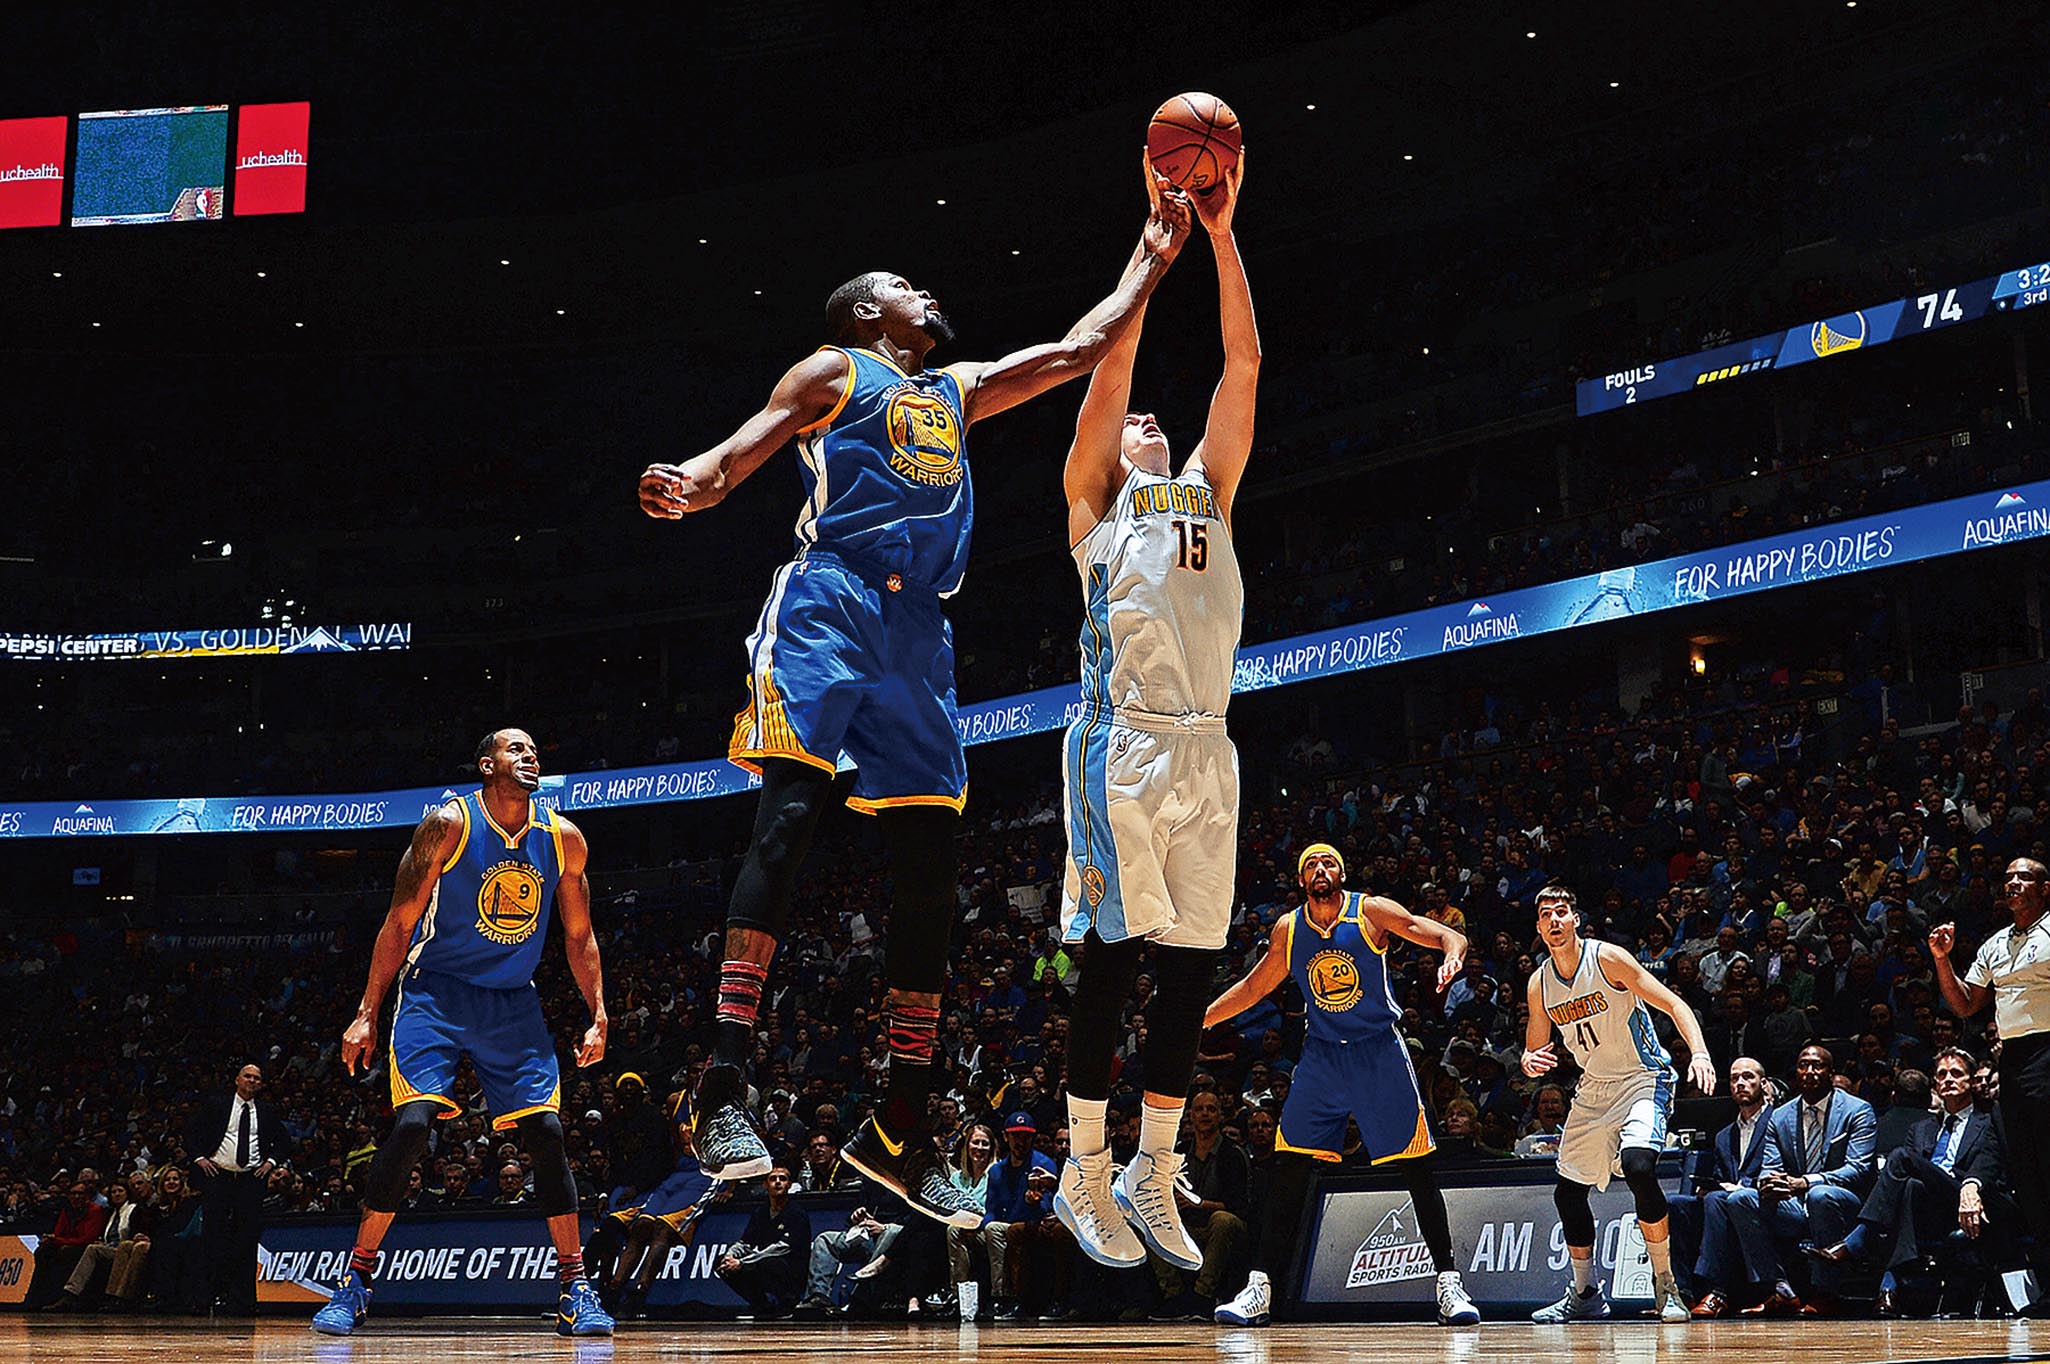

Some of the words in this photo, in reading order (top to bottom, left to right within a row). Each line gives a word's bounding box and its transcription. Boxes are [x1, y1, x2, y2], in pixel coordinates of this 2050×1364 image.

[242, 149, 302, 167] uchealth
[0, 163, 59, 180] uchealth
[1917, 288, 1963, 329] 74
[2024, 288, 2047, 305] 3rd
[1605, 364, 1655, 390] FOULS
[1625, 387, 1637, 404] 2
[920, 410, 947, 430] 35
[1171, 520, 1209, 573] 15
[1674, 564, 1720, 599] FOR
[1727, 547, 1796, 587] HAPPY
[1801, 527, 1895, 572] BODIES
[1442, 613, 1520, 651] AQUAFINA
[0, 638, 55, 654] PEPSI
[61, 638, 137, 654] CENTER
[1273, 643, 1327, 677] HAPPY
[1330, 628, 1403, 668] BODIES
[972, 704, 1031, 738] BODIES
[571, 781, 602, 805] FOR
[607, 776, 655, 800] HAPPY
[656, 769, 717, 797] BODIES
[52, 816, 115, 835] AQUAFINA
[232, 806, 266, 828] FOR
[270, 804, 322, 825] HAPPY
[323, 801, 386, 824] BODIES
[481, 860, 519, 880] GOLDEN
[519, 884, 530, 900] 9
[474, 918, 538, 945] WARRIORS
[1331, 964, 1349, 978] 20
[1315, 989, 1365, 1013] WARRIORS
[1547, 991, 1609, 1026] NUGGETS
[1575, 1021, 1601, 1052] 41
[1469, 1222, 1534, 1272] AM
[258, 1251, 315, 1281] NEW
[387, 1247, 464, 1281] HOME
[466, 1247, 500, 1280] OF
[507, 1247, 559, 1280] THE
[1350, 1267, 1400, 1284] SPORTS
